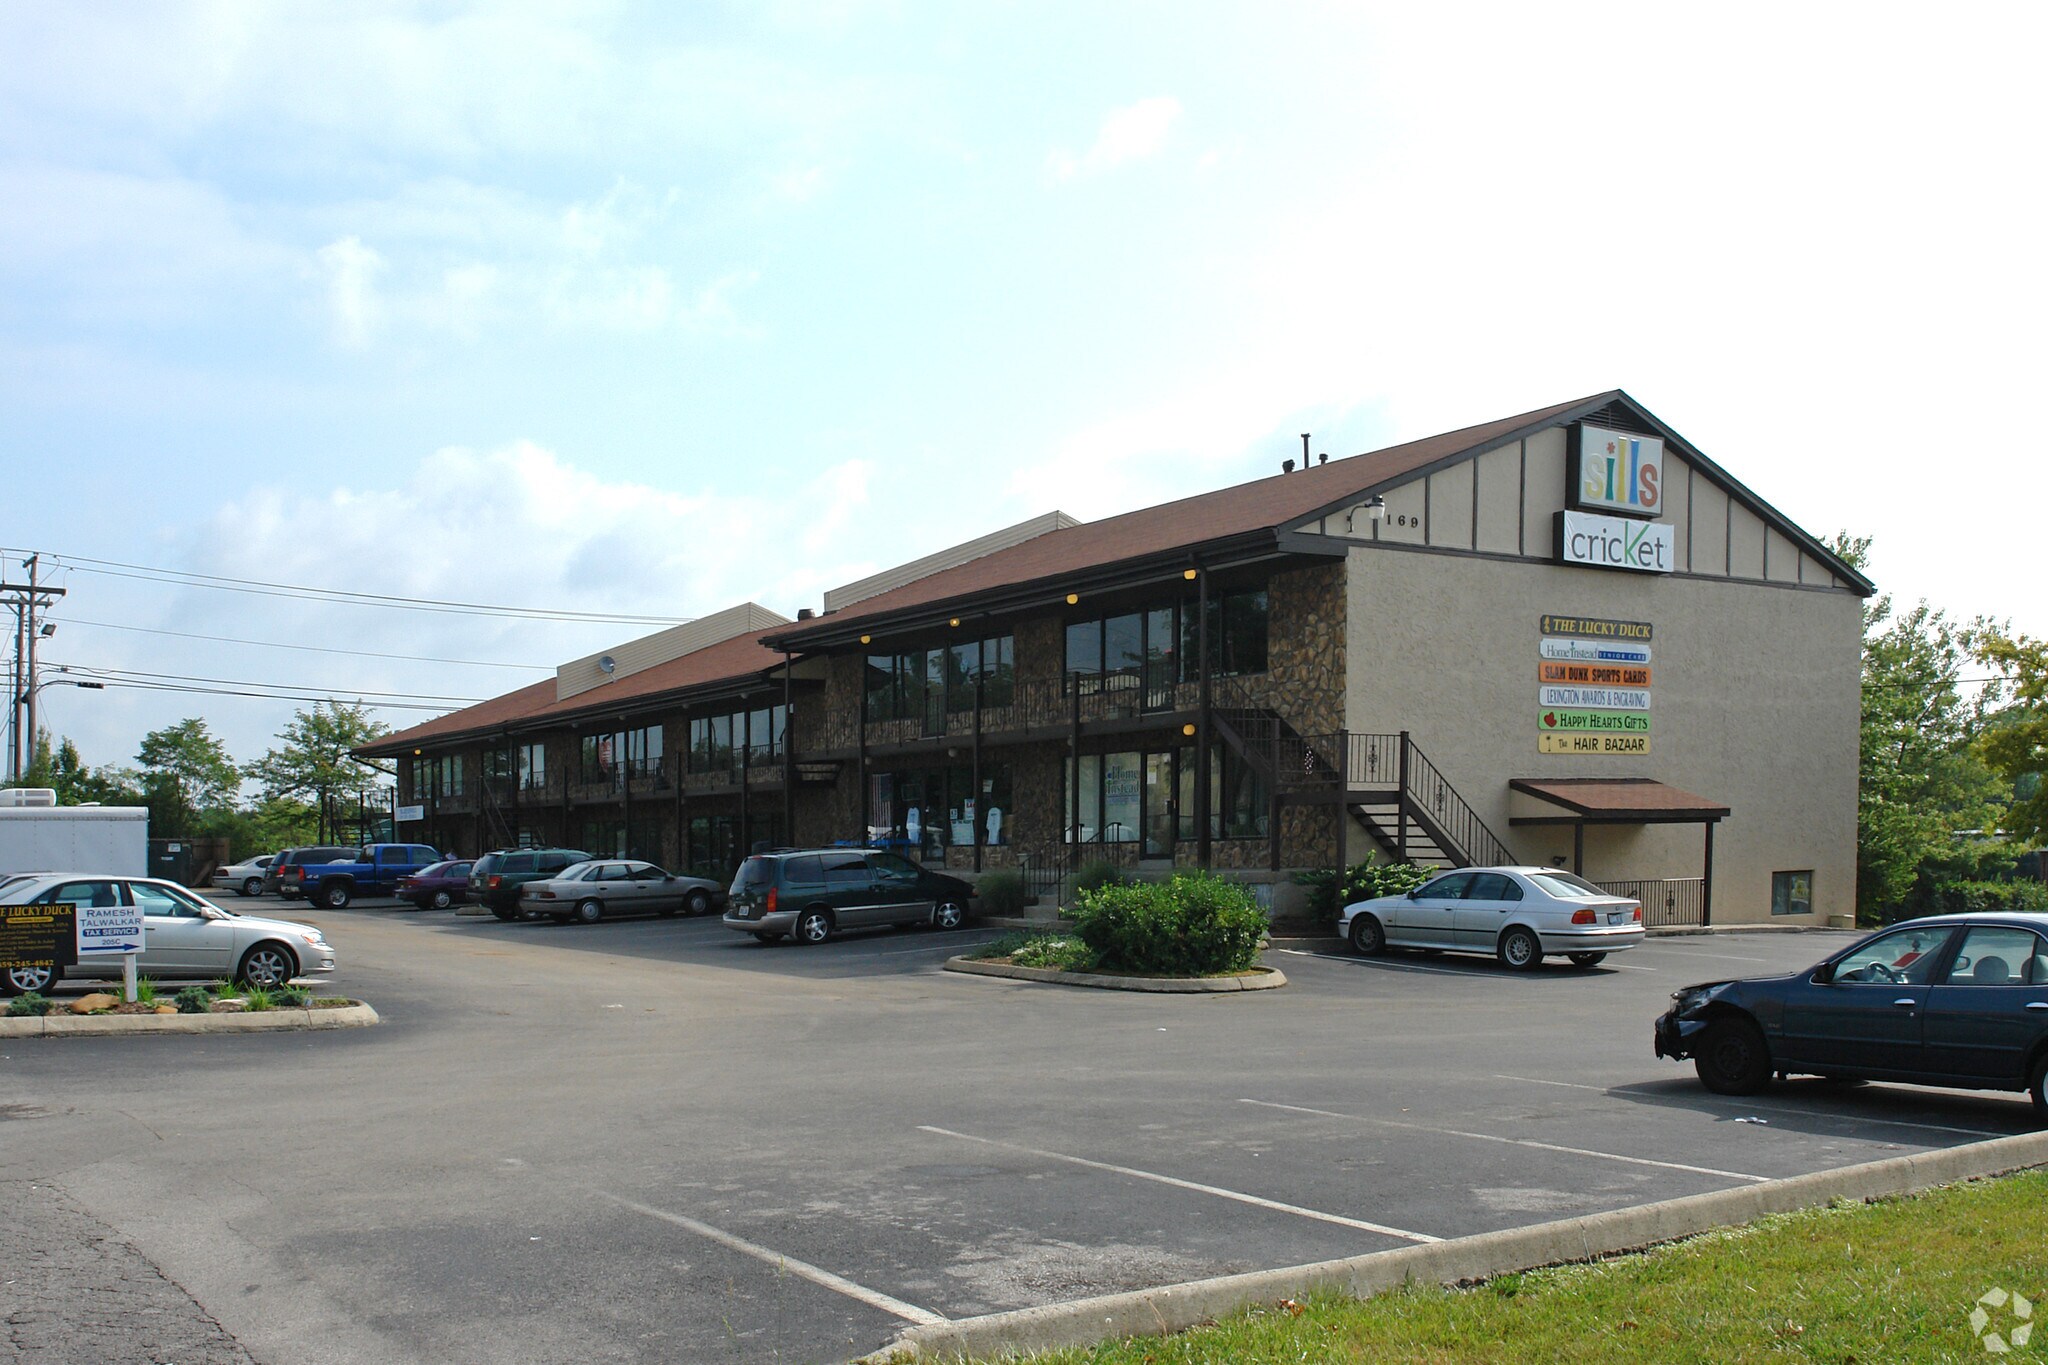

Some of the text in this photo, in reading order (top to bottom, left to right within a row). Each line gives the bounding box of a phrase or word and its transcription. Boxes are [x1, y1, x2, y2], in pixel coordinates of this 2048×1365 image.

[1585, 437, 1659, 508] sills
[1553, 619, 1651, 638] THE LUCKY DUCK
[1547, 645, 1569, 658] Home
[1545, 665, 1647, 684] SLAM DUNK SPORTS CARDS
[1547, 689, 1580, 704] LEXINGTON
[1582, 690, 1606, 706] AWARDS
[1614, 692, 1645, 708] ENGRAVING
[1574, 738, 1599, 751] HAIR
[1605, 738, 1645, 752] BAZAAR
[8, 906, 42, 917] LUCKY
[43, 905, 72, 916] DUCK
[86, 909, 135, 918] RAMESH
[80, 918, 142, 927] TALWALKAR
[85, 927, 138, 937] TAX SERVICE
